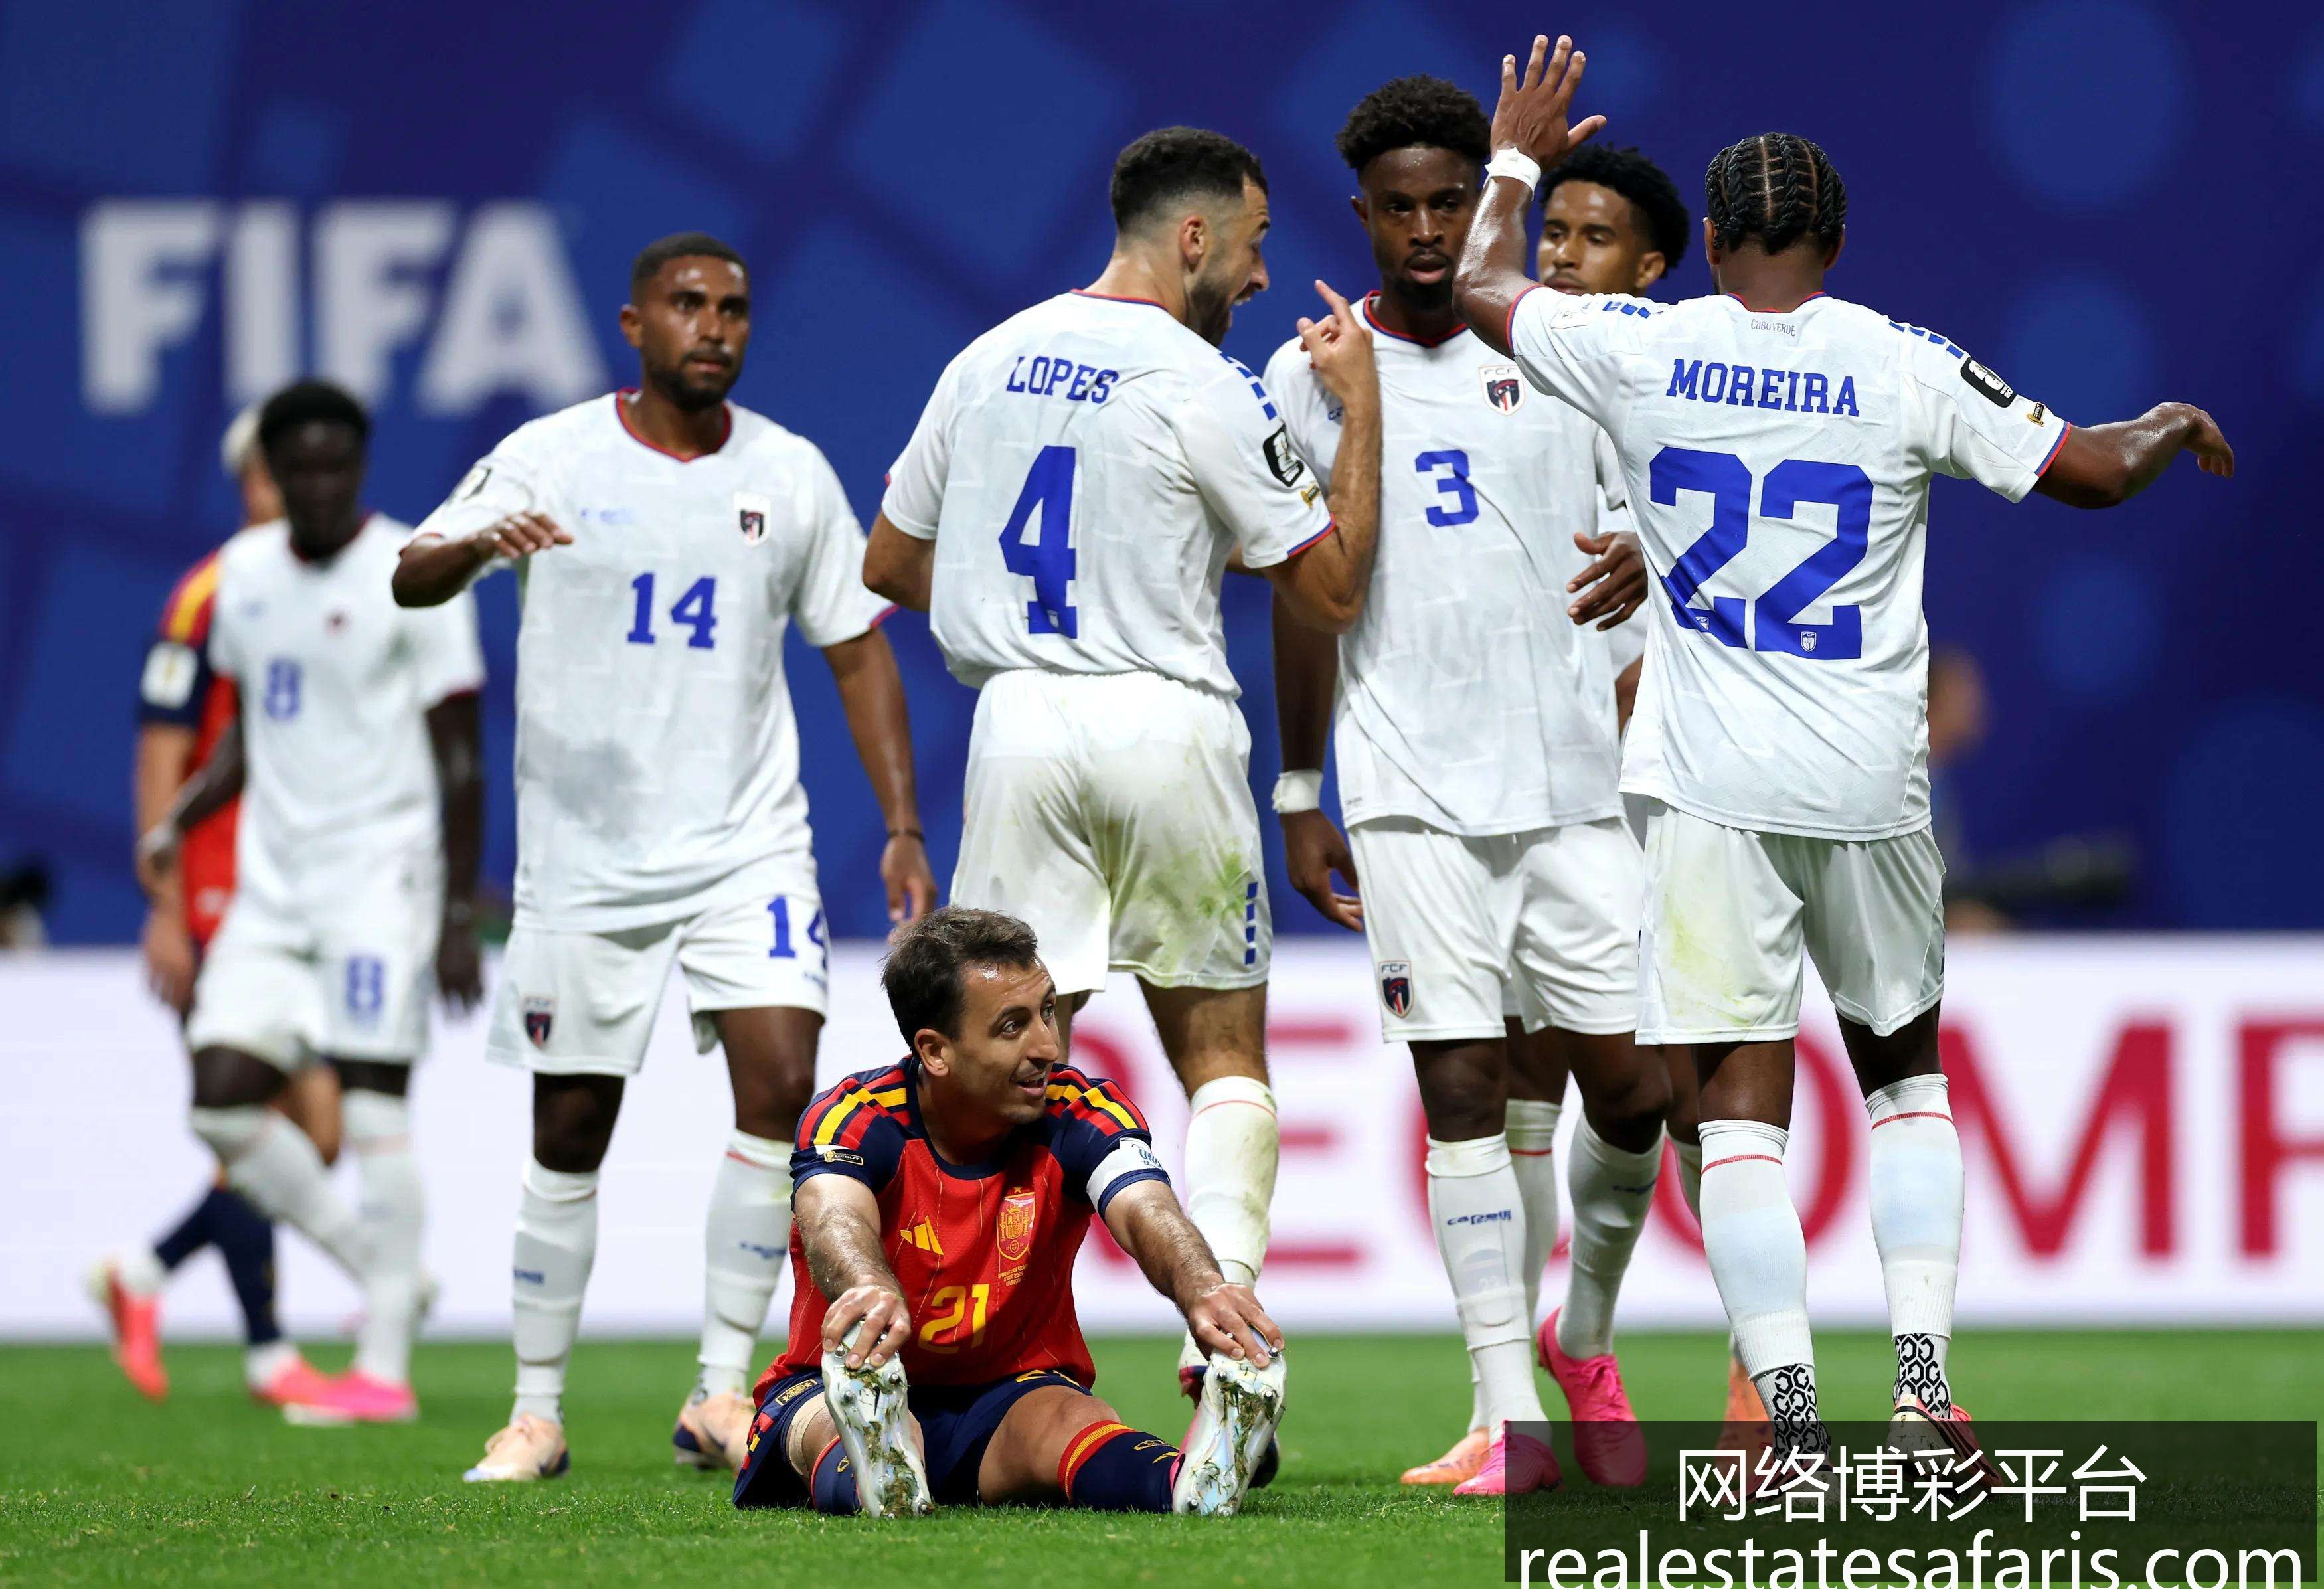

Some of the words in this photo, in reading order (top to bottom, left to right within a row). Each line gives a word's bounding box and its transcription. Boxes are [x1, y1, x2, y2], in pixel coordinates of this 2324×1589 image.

[80, 203, 606, 412] FIFA
[1006, 356, 1119, 404] LOPES
[1666, 358, 1859, 417] MOREIRA
[1414, 450, 1479, 527] 3
[999, 445, 1078, 639] 4
[1649, 446, 1874, 661] 22
[627, 572, 717, 649] 14
[265, 655, 303, 722] 8
[345, 954, 383, 1025] 8
[1382, 964, 1407, 973] FCF
[919, 1283, 990, 1355] 21
